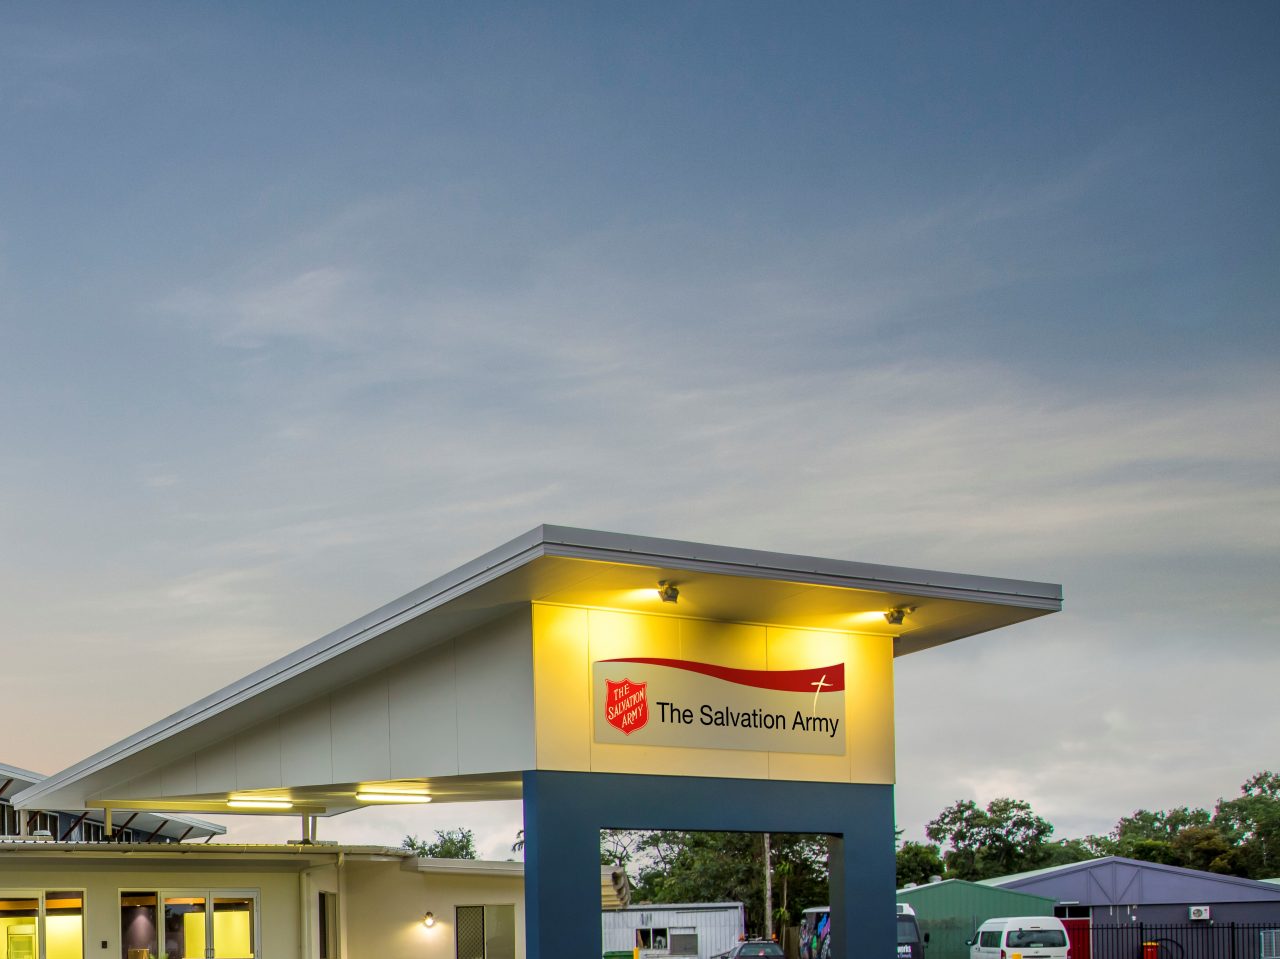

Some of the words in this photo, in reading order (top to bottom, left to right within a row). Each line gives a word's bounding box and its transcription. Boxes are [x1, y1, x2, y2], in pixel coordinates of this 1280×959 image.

[608, 687, 645, 720] SALVATION
[613, 683, 630, 701] THE
[621, 704, 644, 728] ARMY
[656, 701, 693, 724] The
[699, 704, 786, 730] Salvation
[792, 710, 839, 738] Army
